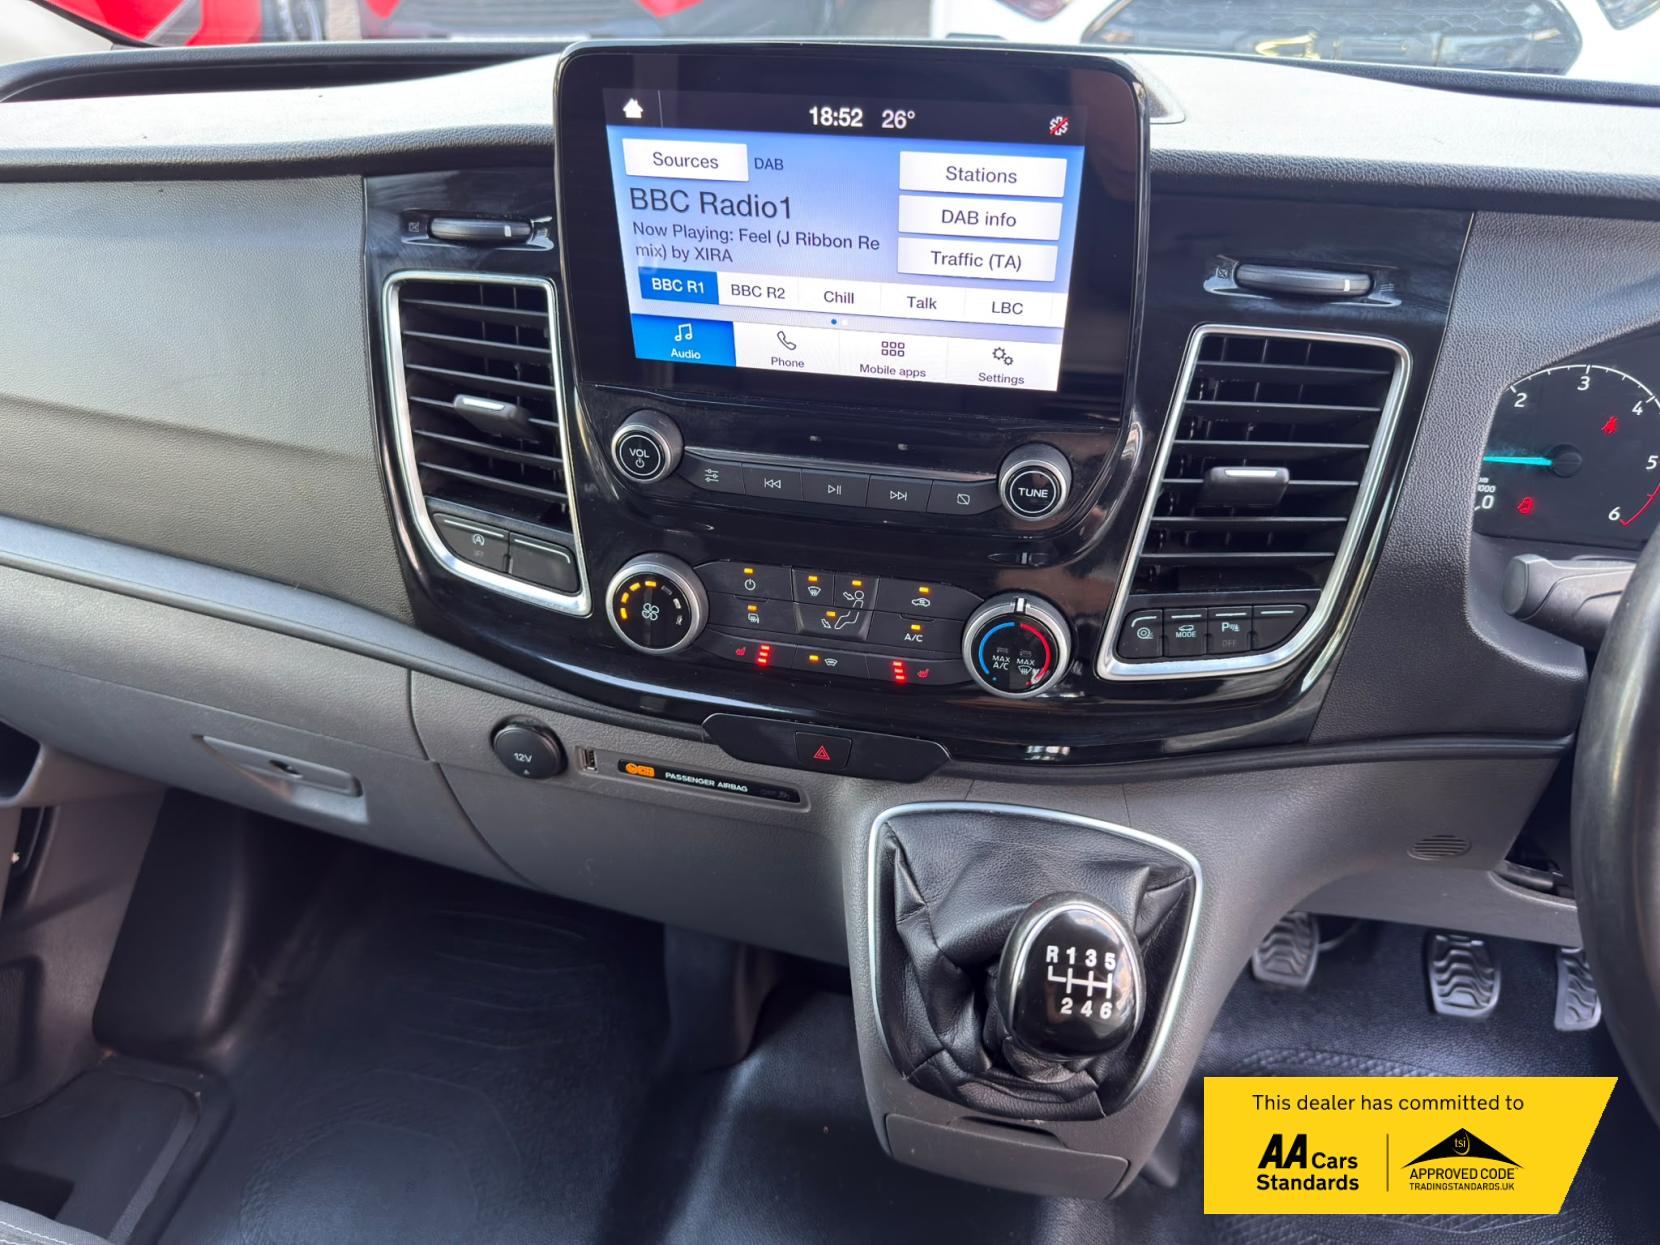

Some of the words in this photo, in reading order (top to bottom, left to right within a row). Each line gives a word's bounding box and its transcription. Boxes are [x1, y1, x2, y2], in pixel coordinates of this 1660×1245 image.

[809, 106, 863, 128] 18:52
[881, 110, 915, 129] 26°
[652, 152, 719, 170] Sources
[754, 157, 784, 171] DAB
[945, 165, 1018, 185] Stations
[629, 187, 690, 214] BBC
[699, 191, 792, 219] Radio1
[941, 209, 979, 226] DAB
[985, 211, 1017, 228] info
[633, 221, 668, 238] Now
[672, 223, 734, 243] Playing:
[738, 228, 772, 244] Feel
[776, 230, 790, 247] (J
[795, 231, 853, 249] Ribbon
[858, 235, 880, 250] Re
[635, 243, 667, 260] mix)
[671, 244, 690, 263] by
[694, 246, 733, 263] XIRA
[931, 250, 983, 268] Traffic
[988, 252, 1022, 272] (TA)
[651, 277, 683, 293] BBC
[687, 280, 704, 294] R1
[731, 284, 762, 298] BBC
[766, 286, 786, 300] R2
[823, 288, 855, 304] Chill
[907, 296, 937, 310] Talk
[991, 301, 1024, 315] LBC
[671, 348, 701, 360] Audio
[770, 356, 805, 369] Phone
[859, 363, 896, 376] Mobile
[899, 368, 927, 379] apps
[978, 372, 1025, 386] Settings
[1577, 376, 1591, 391] 3
[1514, 392, 1528, 408] 2
[1631, 400, 1644, 416] 4
[629, 447, 650, 458] VOL
[1645, 455, 1659, 470] 5
[1018, 487, 1049, 498] TUNE
[1481, 494, 1495, 510] 0
[1608, 506, 1621, 521] 6
[904, 633, 923, 643] A/C
[1175, 631, 1197, 639] MODE
[992, 655, 1011, 663] MAX
[993, 661, 1009, 671] A/C
[1016, 658, 1035, 666] MAX
[513, 752, 533, 763] 12V
[665, 772, 715, 787] PASSENGER
[717, 781, 748, 793] AIRBAG
[1046, 945, 1059, 963] R
[1066, 947, 1076, 964] 1
[1085, 949, 1097, 967] 3
[1104, 952, 1116, 971] 5
[1060, 997, 1073, 1015] 2
[1080, 1000, 1093, 1018] 4
[1100, 1001, 1113, 1019] 6
